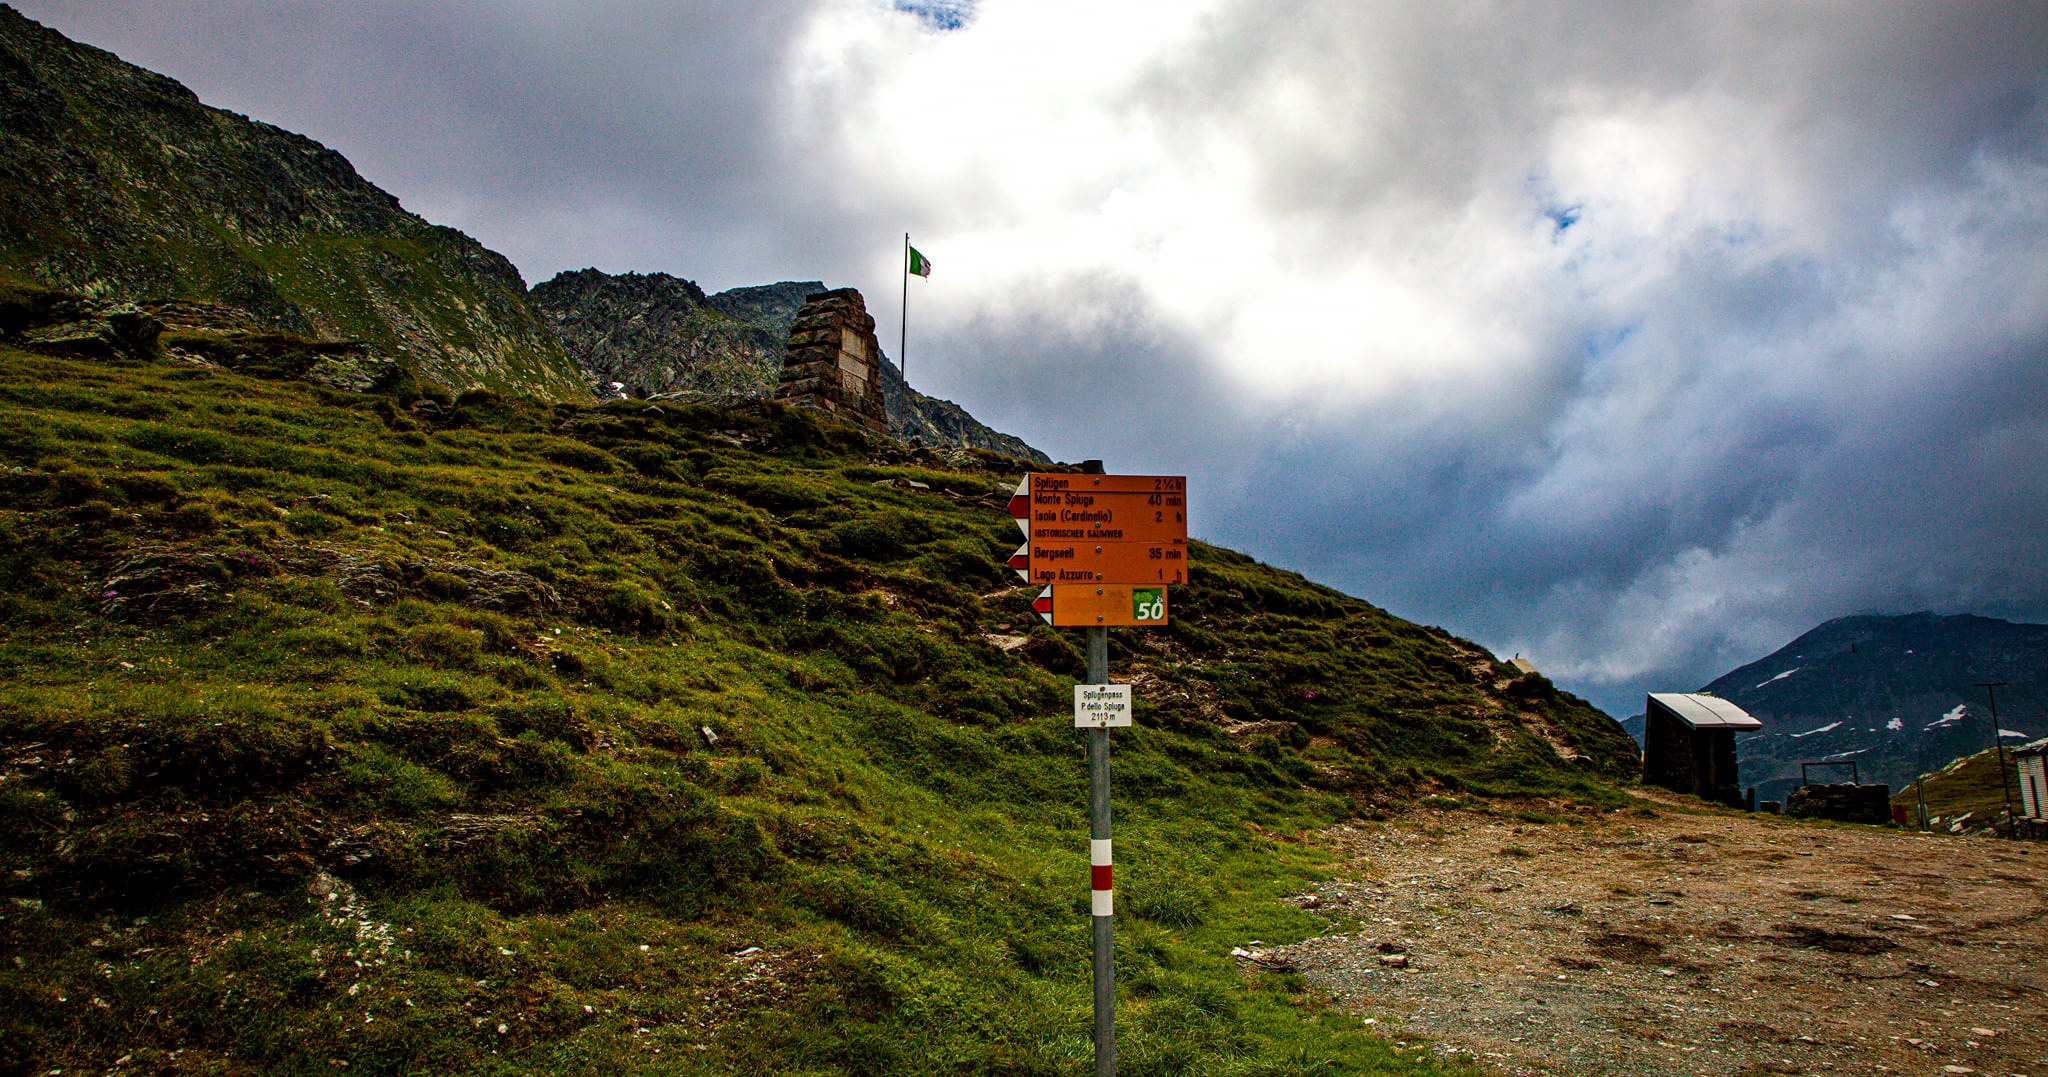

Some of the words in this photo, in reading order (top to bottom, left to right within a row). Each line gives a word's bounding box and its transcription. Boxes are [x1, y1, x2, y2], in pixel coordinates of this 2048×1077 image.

[1035, 477, 1069, 489] Splügen
[1176, 480, 1181, 489] h
[1035, 494, 1061, 504] Monte
[1065, 494, 1094, 507] Spluga
[1148, 495, 1162, 506] 40
[1166, 496, 1181, 506] min
[1035, 510, 1056, 521] Isola
[1061, 509, 1112, 522] (Cardinello)
[1155, 512, 1162, 522] 2
[1177, 512, 1181, 522] h
[1087, 530, 1123, 538] SAUMWEG
[1149, 548, 1162, 559] 35
[1166, 549, 1181, 559] min
[1035, 569, 1056, 582] Lago
[1059, 569, 1093, 579] Azzurro
[1158, 569, 1163, 579] 1
[1176, 570, 1181, 580] h
[1137, 603, 1163, 619] 50
[1083, 691, 1123, 700] Splügenpass
[1104, 702, 1125, 711] Spluga
